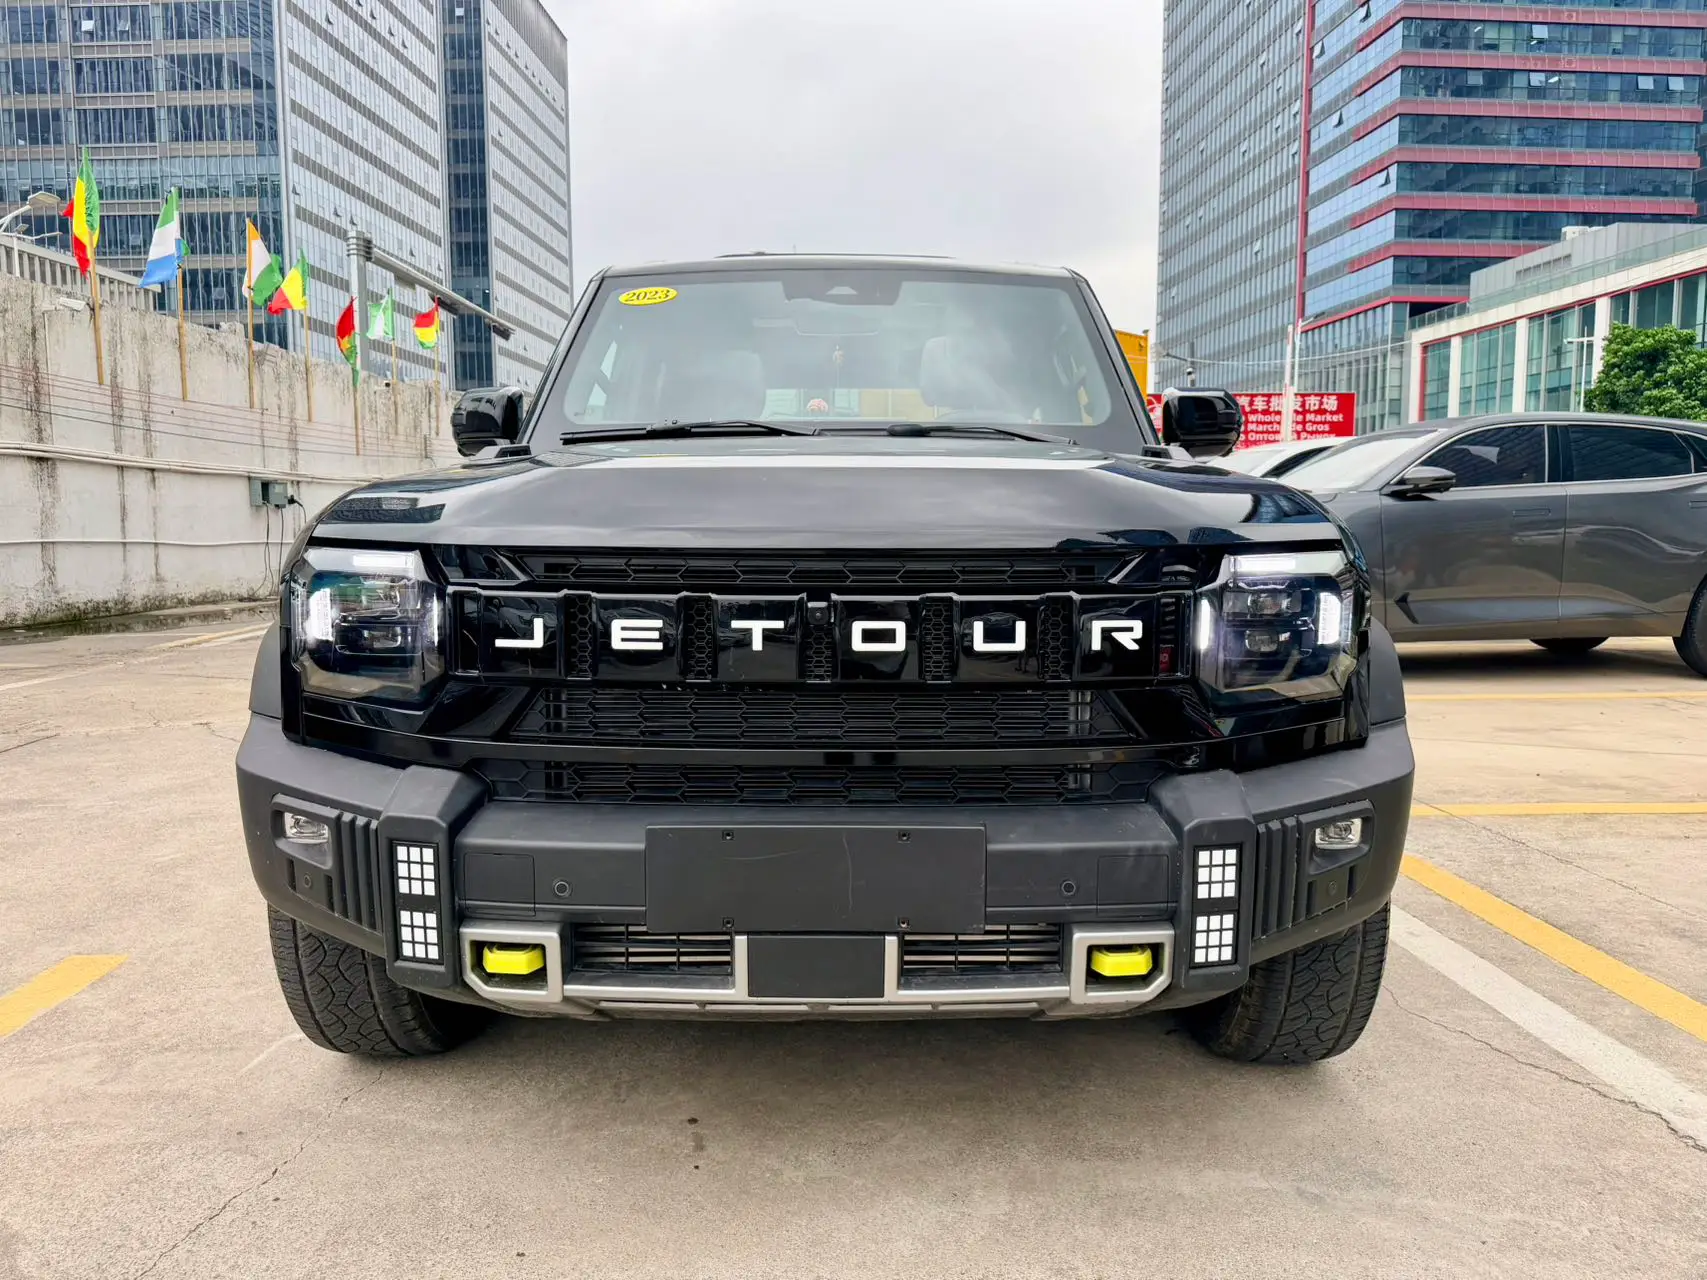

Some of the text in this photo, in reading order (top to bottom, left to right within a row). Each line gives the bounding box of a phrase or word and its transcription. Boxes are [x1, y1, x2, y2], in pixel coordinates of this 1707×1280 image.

[625, 289, 670, 302] 2023
[1305, 413, 1344, 422] Market
[1305, 422, 1330, 431] Gros
[494, 618, 1144, 652] JETOUR
